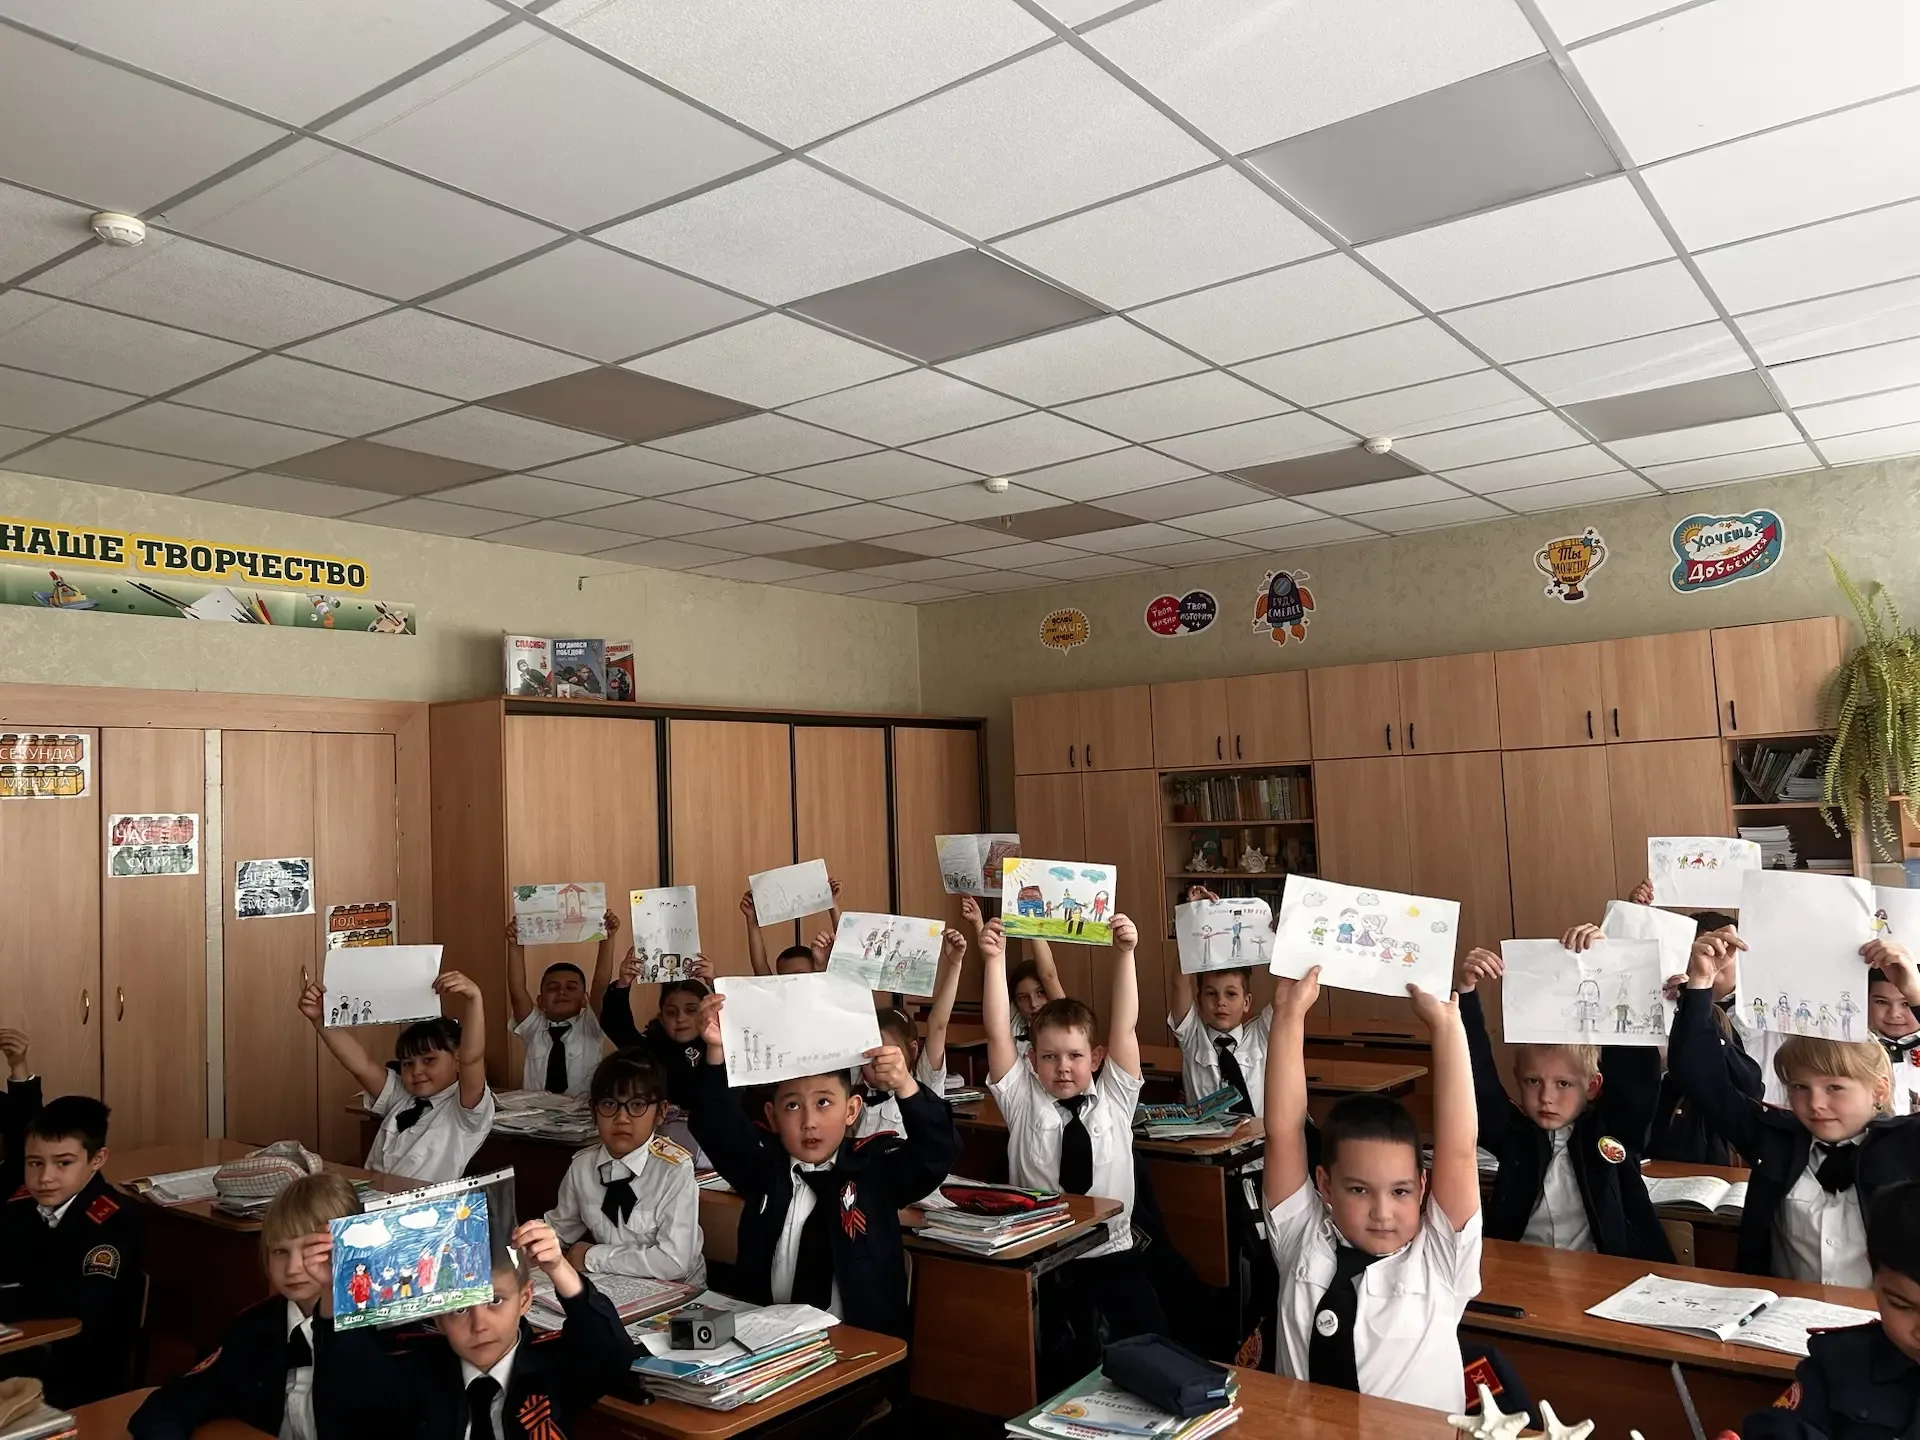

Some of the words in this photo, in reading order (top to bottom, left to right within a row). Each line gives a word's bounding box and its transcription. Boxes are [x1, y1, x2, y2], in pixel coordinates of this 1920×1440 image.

[0, 524, 124, 563] НАШЕ
[137, 540, 366, 588] ТВОРЧЕСТВО
[1268, 604, 1301, 618] СМЕЛЕЕ
[0, 748, 74, 762] СЕКУНДА
[4, 777, 71, 789] МИНУТА
[115, 829, 153, 843] ЧАС
[128, 856, 171, 870] СУТКИ
[248, 896, 294, 910] МЕСЯЦ
[332, 916, 356, 928] ГОД
